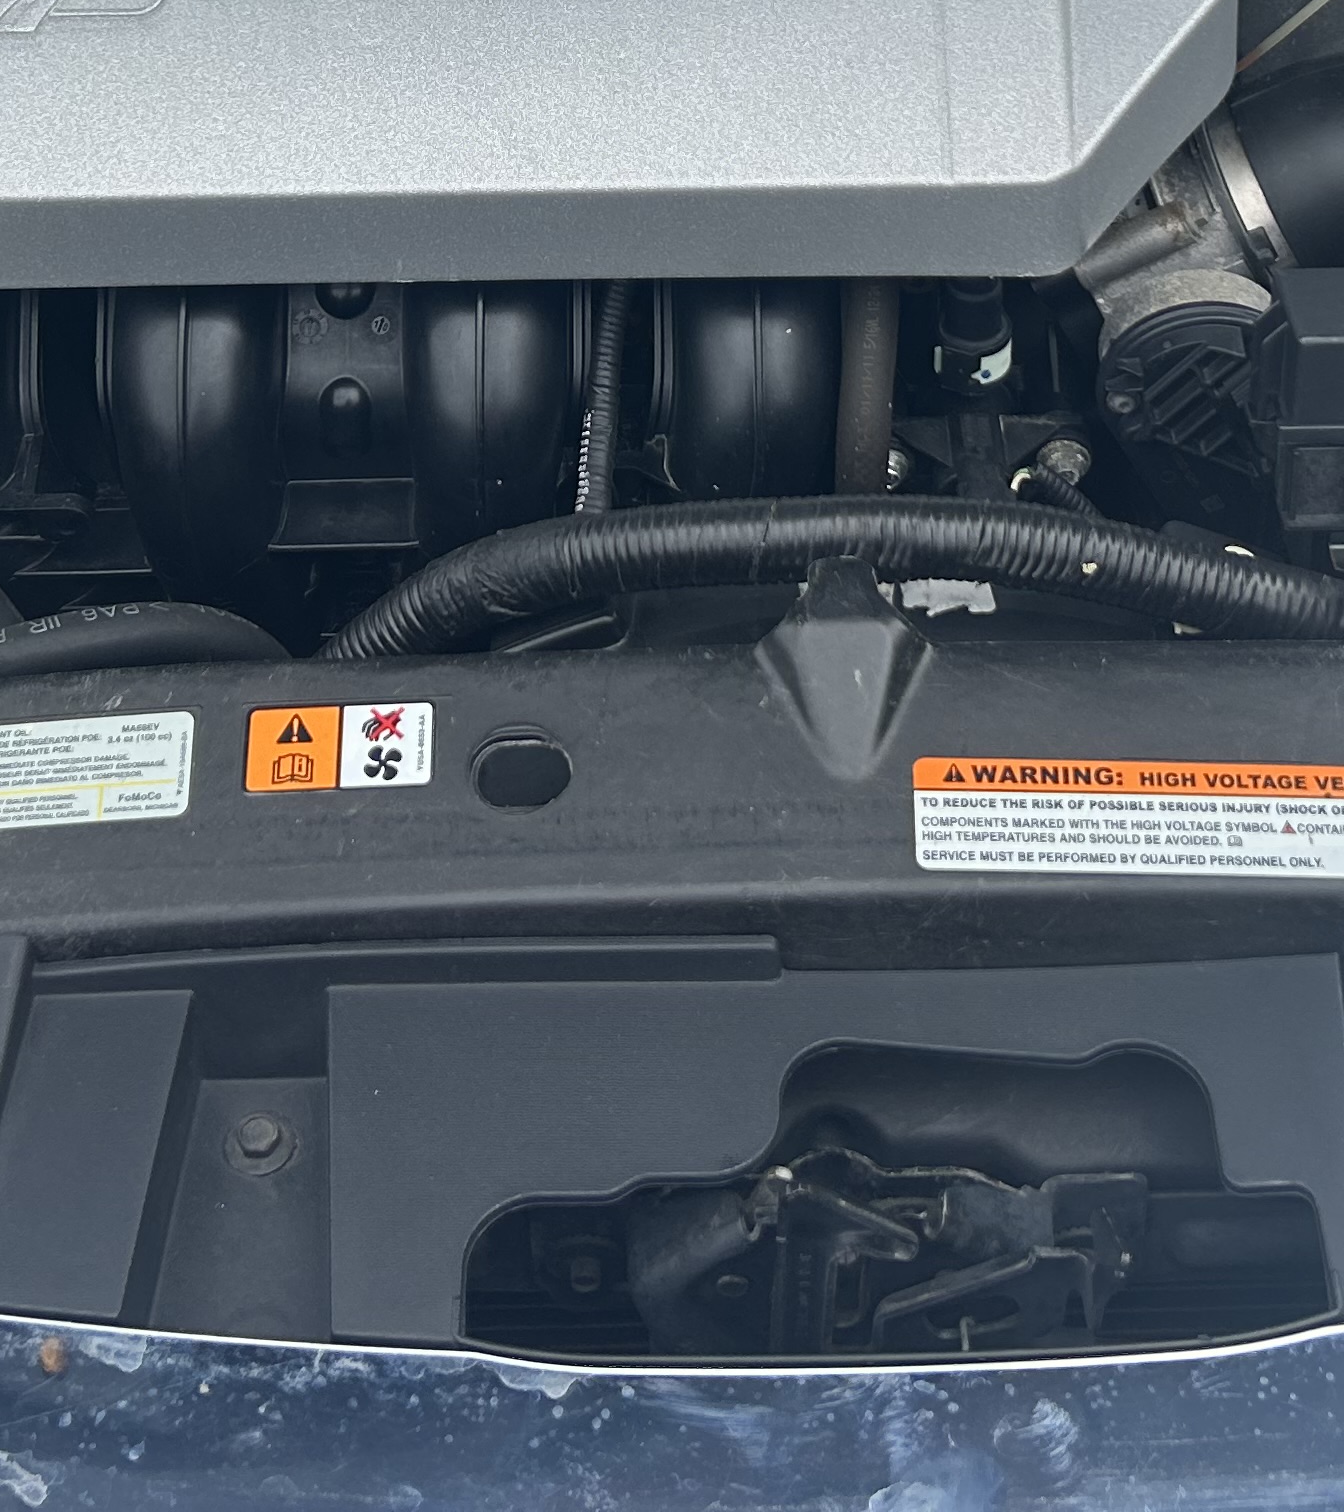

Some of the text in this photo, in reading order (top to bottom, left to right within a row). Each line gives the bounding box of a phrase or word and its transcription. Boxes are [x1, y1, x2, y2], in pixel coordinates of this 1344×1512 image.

[971, 764, 1123, 786] WARNING:
[1139, 771, 1196, 787] HIGH
[1202, 772, 1307, 790] VOLTAGE
[117, 791, 162, 803] FoMoCo
[920, 796, 939, 807] TO
[942, 796, 997, 808] REDUCE
[999, 798, 1027, 809] THE
[1031, 798, 1064, 809] RISK
[1067, 799, 1085, 810] OF
[1088, 799, 1155, 811] POSSIBLE
[1158, 800, 1218, 813] SERIOUS
[1221, 802, 1271, 814] INJURY
[1275, 802, 1328, 815] (SHOCK
[920, 816, 1009, 828] COMPONENTS
[1011, 817, 1065, 829] MARKED
[1067, 818, 1100, 830] WITH
[1101, 818, 1128, 830] THE
[1130, 819, 1162, 831] HIGH
[1163, 820, 1222, 832] VOLTAGE
[1224, 821, 1278, 834] SYMBOL
[921, 829, 1222, 847] HIGH TEMPERATURES AND SHOULD BE AVOIDED.
[922, 849, 976, 861] SERVICE
[979, 850, 1014, 862] MUST
[1017, 851, 1035, 862] BE
[1037, 851, 1117, 864] PERFORMED
[1119, 852, 1136, 864] BY
[1139, 852, 1206, 865] QUALIFIED
[1209, 854, 1287, 868] PERSONNEL
